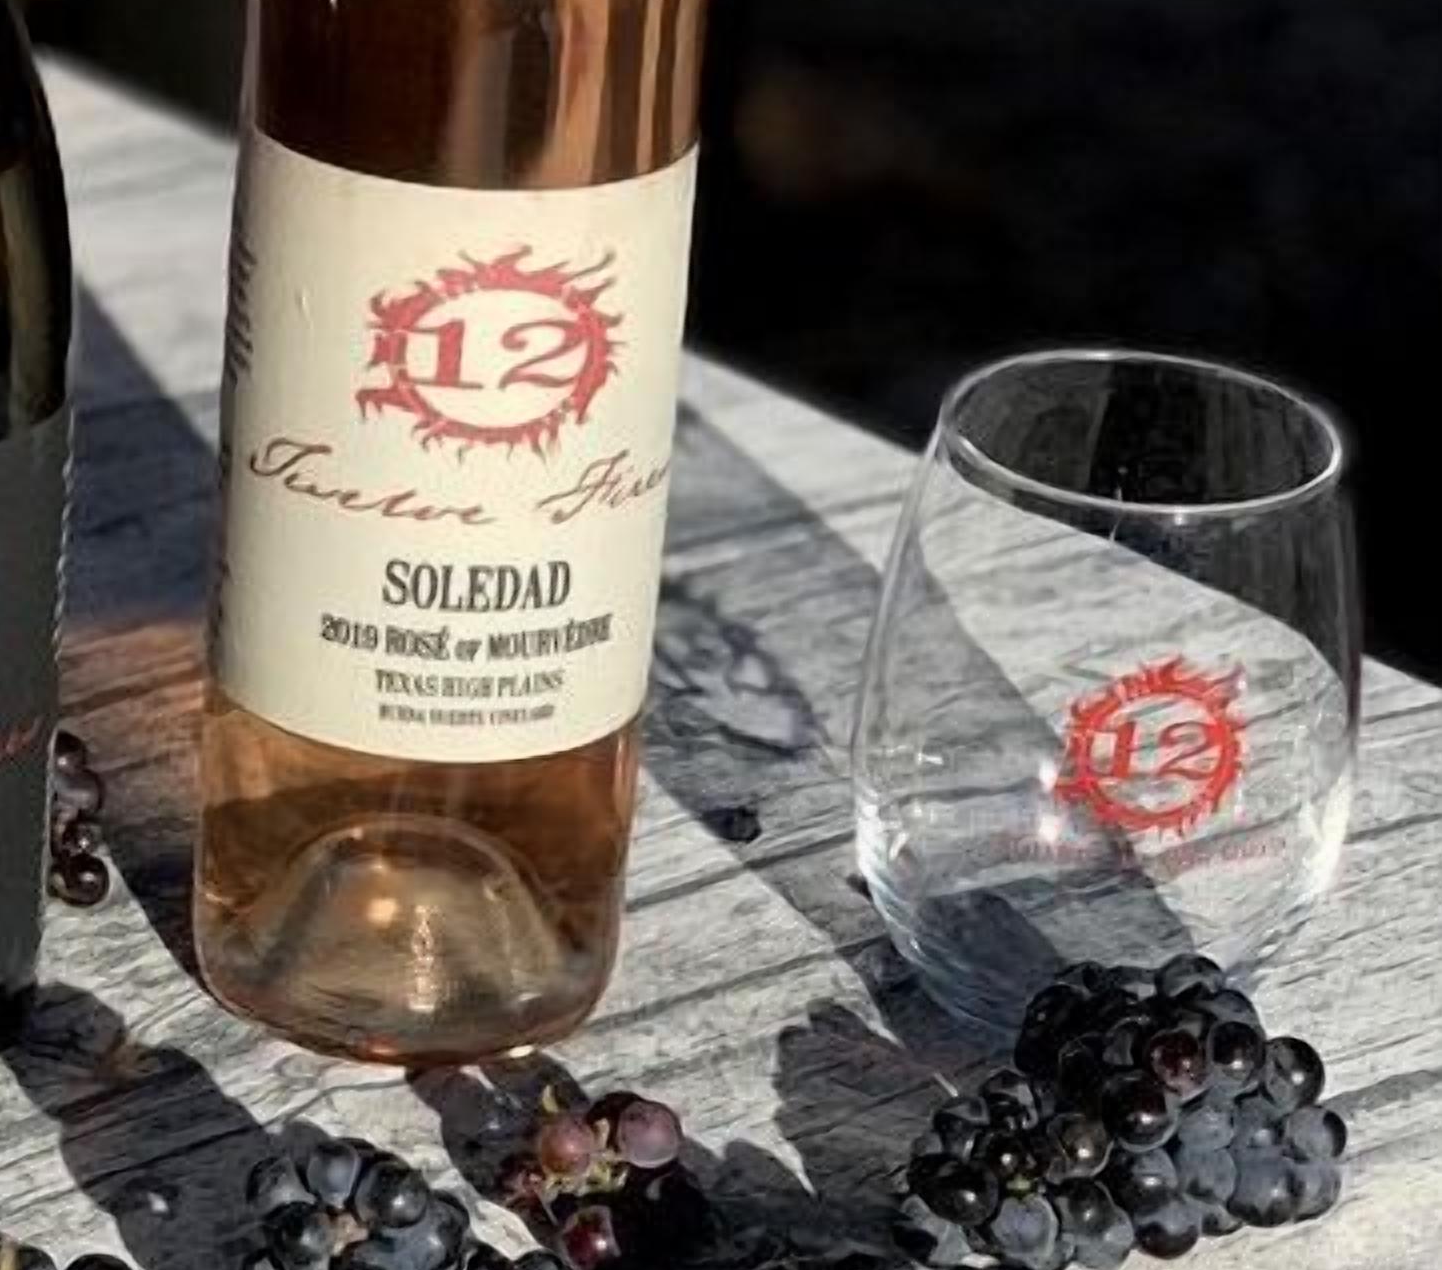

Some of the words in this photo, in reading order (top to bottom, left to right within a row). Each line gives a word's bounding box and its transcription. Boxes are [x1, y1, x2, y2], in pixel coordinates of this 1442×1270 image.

[404, 317, 579, 391] 12
[382, 558, 571, 613] SOLEDAD
[321, 612, 378, 651] 2019
[375, 669, 439, 696] TEXAS
[442, 675, 491, 698] HIGH
[497, 669, 565, 698] PLAINS
[1085, 719, 1220, 782] 12
